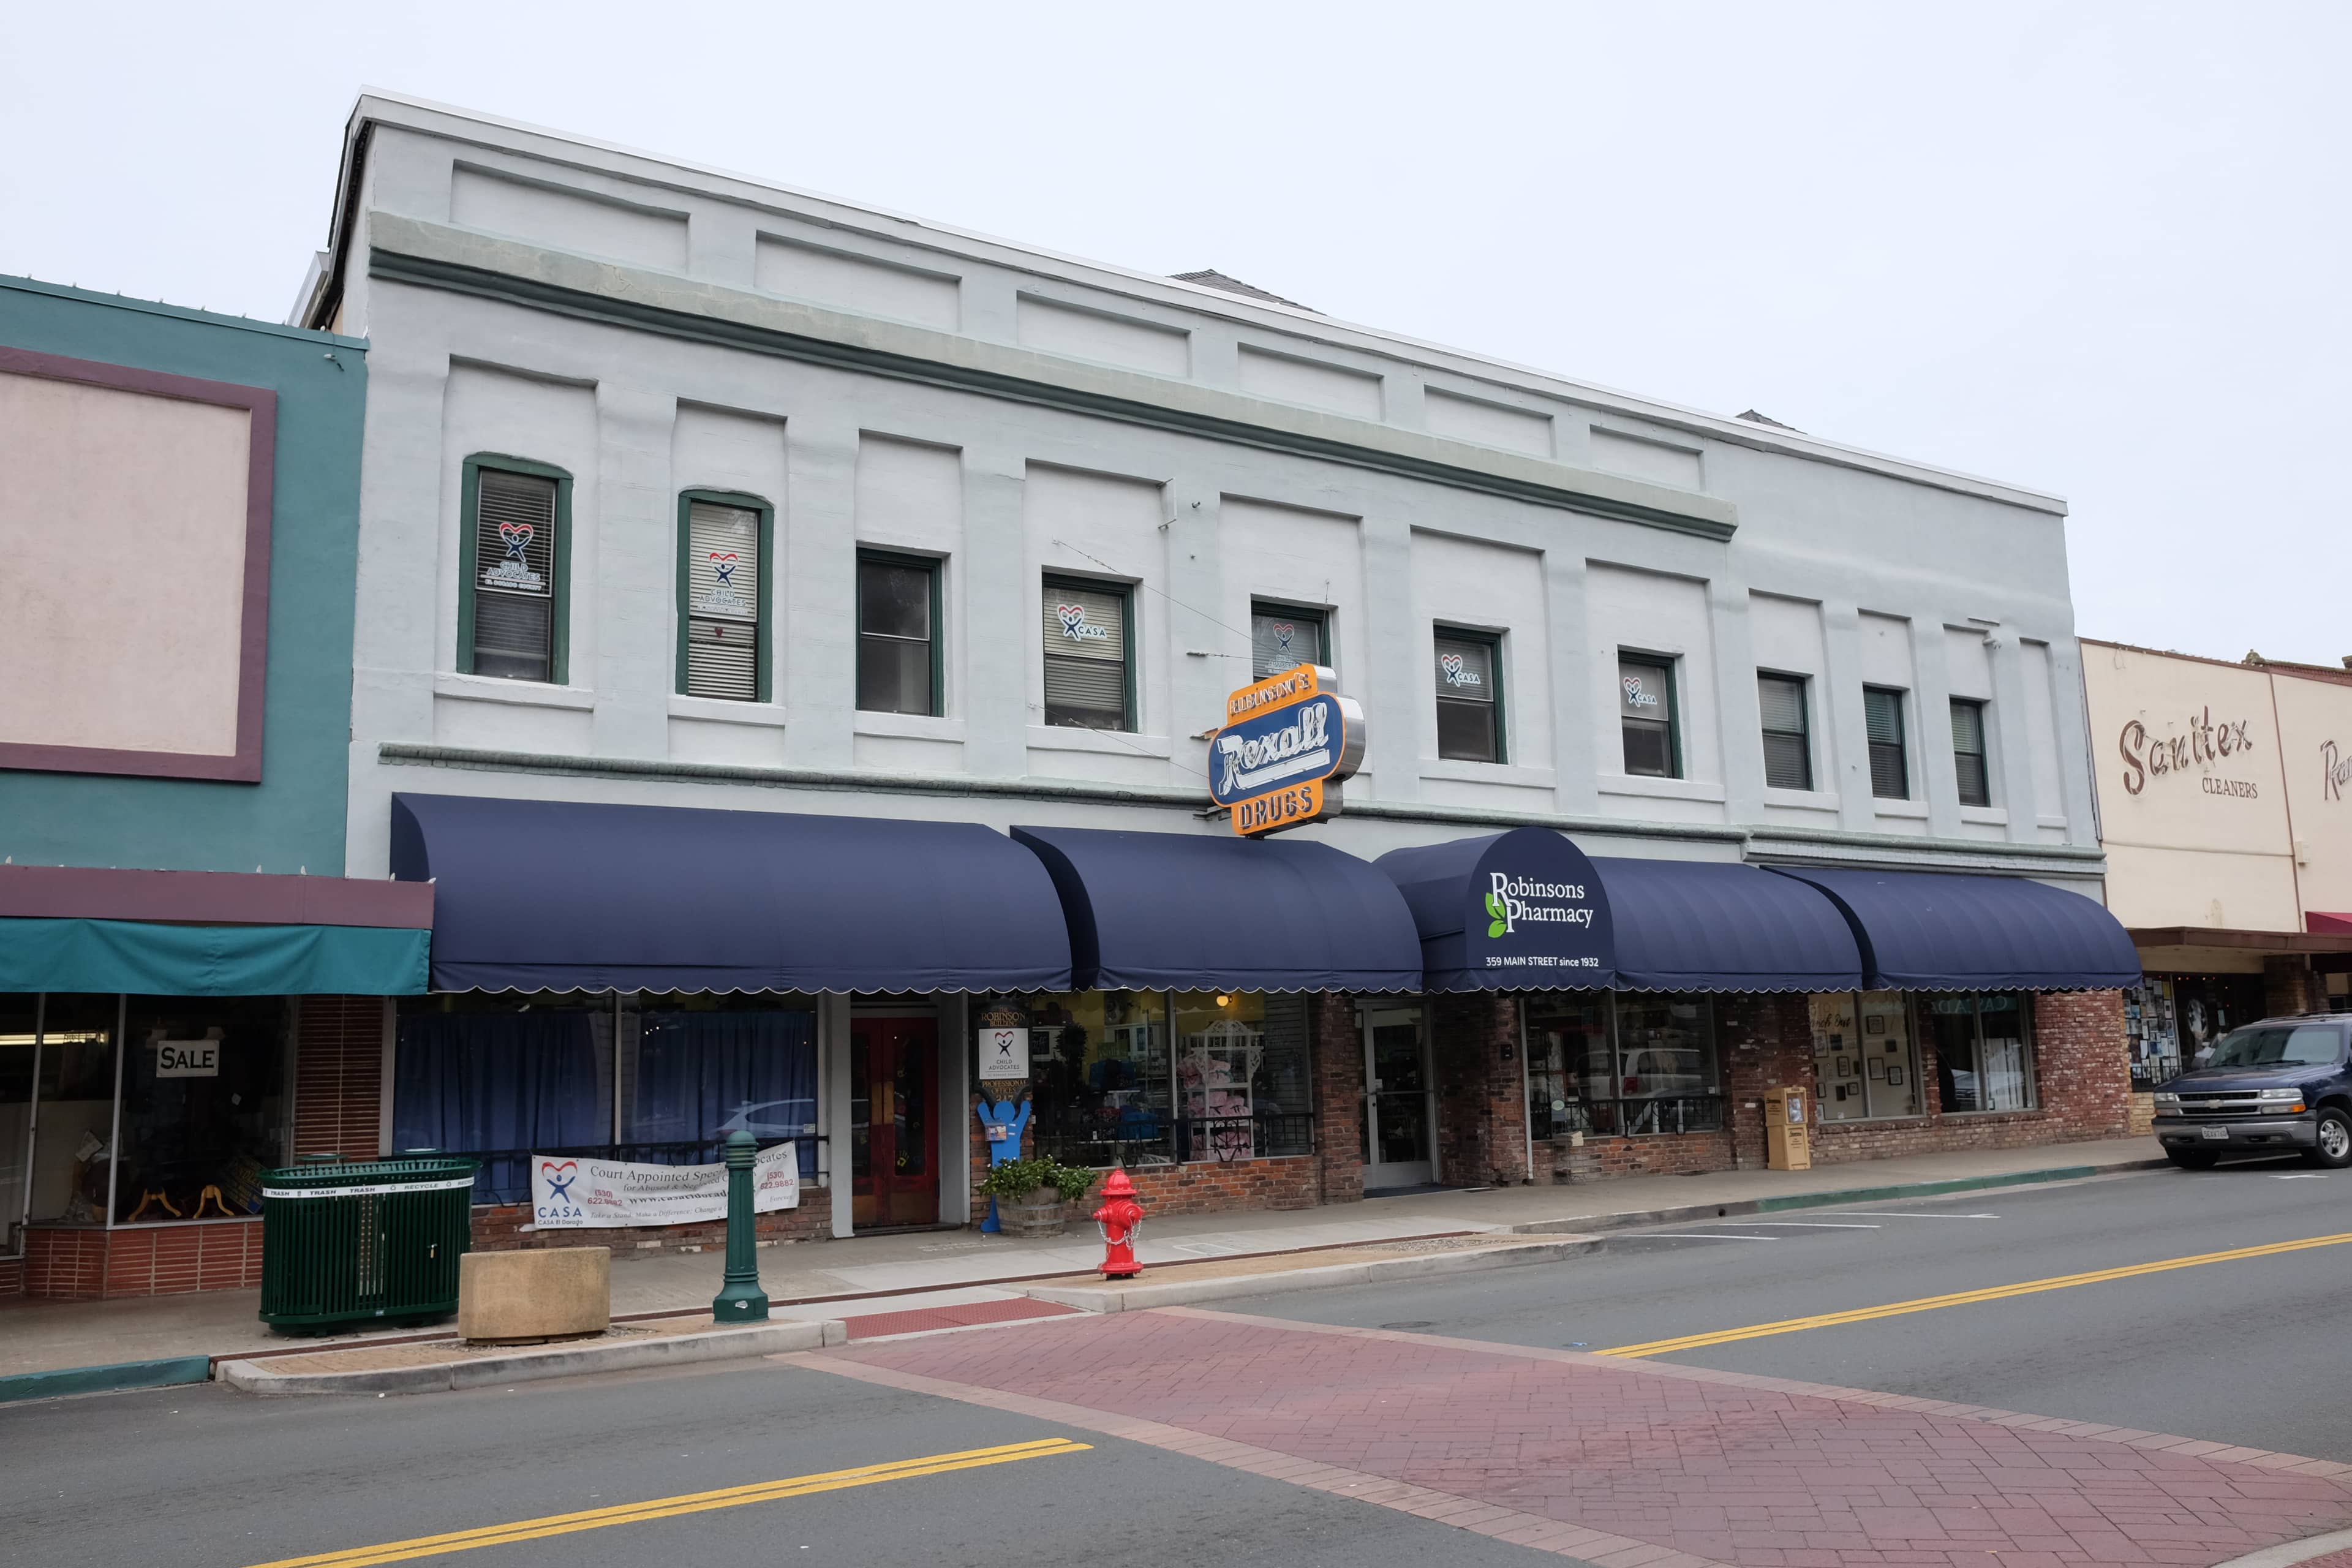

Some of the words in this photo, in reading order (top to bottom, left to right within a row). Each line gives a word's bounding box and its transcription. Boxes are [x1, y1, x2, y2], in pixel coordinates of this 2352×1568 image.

[500, 561, 529, 572] CHILD
[486, 567, 540, 581] ADVOCATES
[710, 589, 735, 597] CHILD
[699, 595, 746, 606] ADVOCATES
[1078, 626, 1106, 636] CASA
[1458, 673, 1479, 682] CASA
[1638, 694, 1656, 704] CASA
[1217, 703, 1330, 796] Rexall
[2119, 705, 2253, 796] Sanitex
[2202, 777, 2258, 799] CLEANERS
[1238, 786, 1313, 829] DRUGS
[1490, 872, 1585, 907] Robinsons
[1506, 899, 1594, 932] Pharmacy
[1485, 957, 1502, 967] 359
[1504, 957, 1526, 966] MAIN
[1528, 957, 1558, 966] STREET
[1559, 957, 1579, 967] since
[1580, 957, 1599, 967] 1932
[981, 1012, 1026, 1022] ROBINSON
[160, 1047, 215, 1069] SALE
[590, 1166, 622, 1180] Court
[627, 1170, 689, 1183] Appointed
[767, 1171, 785, 1181] (530)
[760, 1180, 794, 1190] 622.9882
[595, 1189, 613, 1199] (530)
[538, 1206, 582, 1218] CASA
